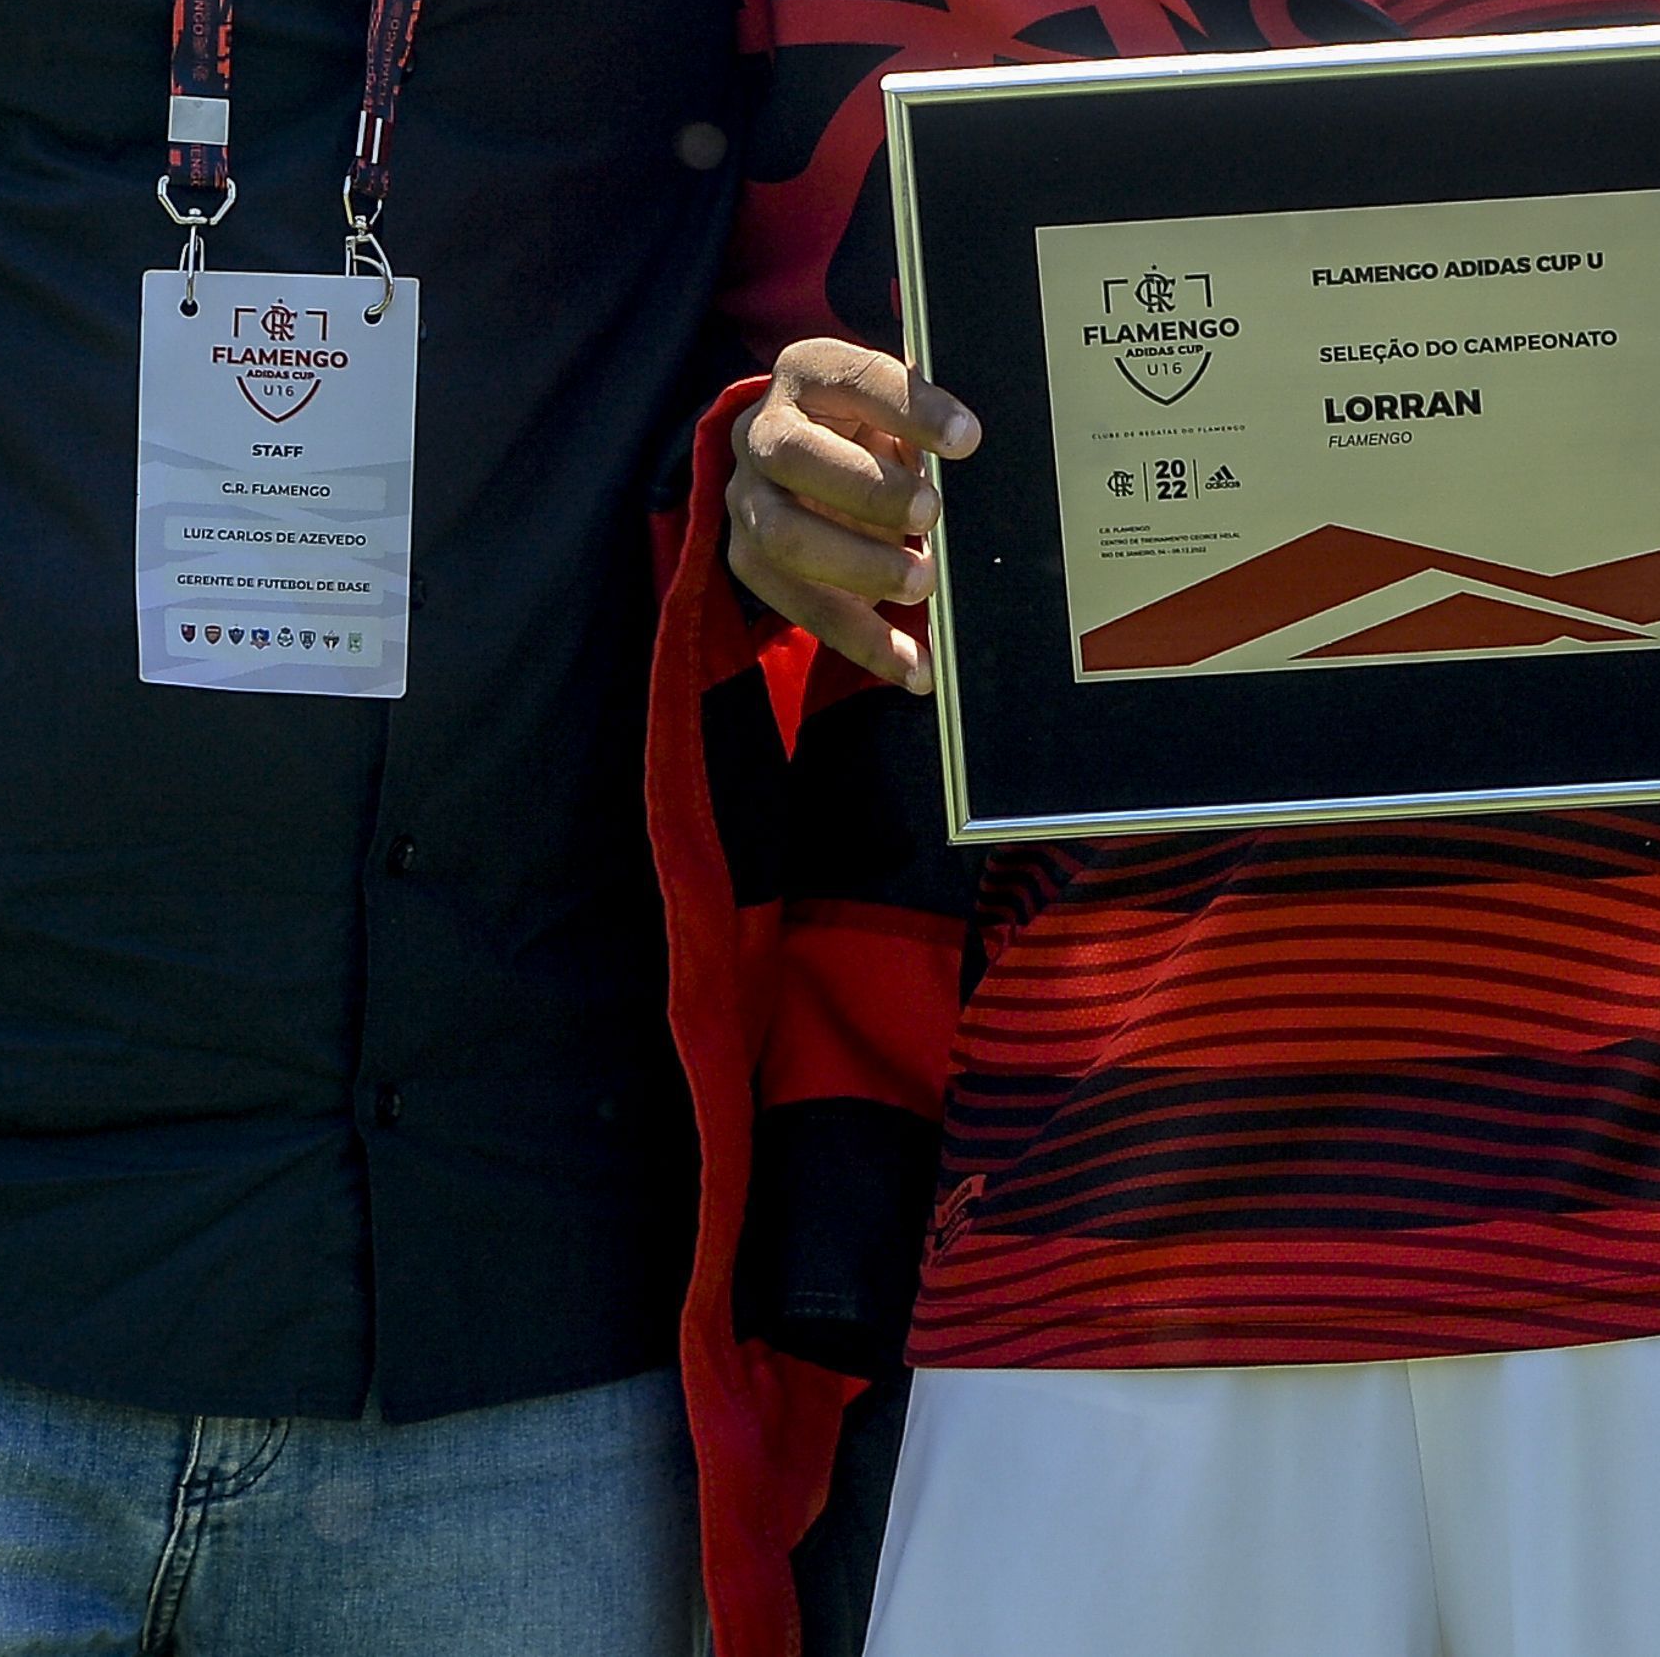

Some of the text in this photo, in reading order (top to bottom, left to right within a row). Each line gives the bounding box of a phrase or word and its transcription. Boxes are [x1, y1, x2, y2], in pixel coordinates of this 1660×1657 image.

[1312, 252, 1604, 286] FLAMENGO ADIDAS CUP U
[1083, 317, 1240, 346] FLAMENGO
[1125, 344, 1204, 358] ADIDAS CUP
[1319, 329, 1618, 364] SELEÇÃO DO CAMPEONATO
[211, 346, 349, 369] FLAMENGO
[246, 369, 316, 380] ADIDAS CUP
[1147, 362, 1182, 376] U16
[263, 385, 295, 397] U16
[1324, 389, 1483, 424] LORRAN
[1091, 431, 1119, 440] CLUBE
[1197, 424, 1246, 433] FLAMENGO
[1328, 431, 1413, 448] FLAMENGO
[252, 444, 304, 458] STAFF
[1155, 459, 1186, 479] 20
[222, 482, 331, 497] C.R. FLAMENGO
[1156, 480, 1188, 500] 22
[1205, 480, 1241, 490] adidas
[183, 528, 367, 546] LUIZ CARLOS DE AZEVEDO
[177, 574, 371, 593] GERENTE DE FUTEBOL DE BASE
